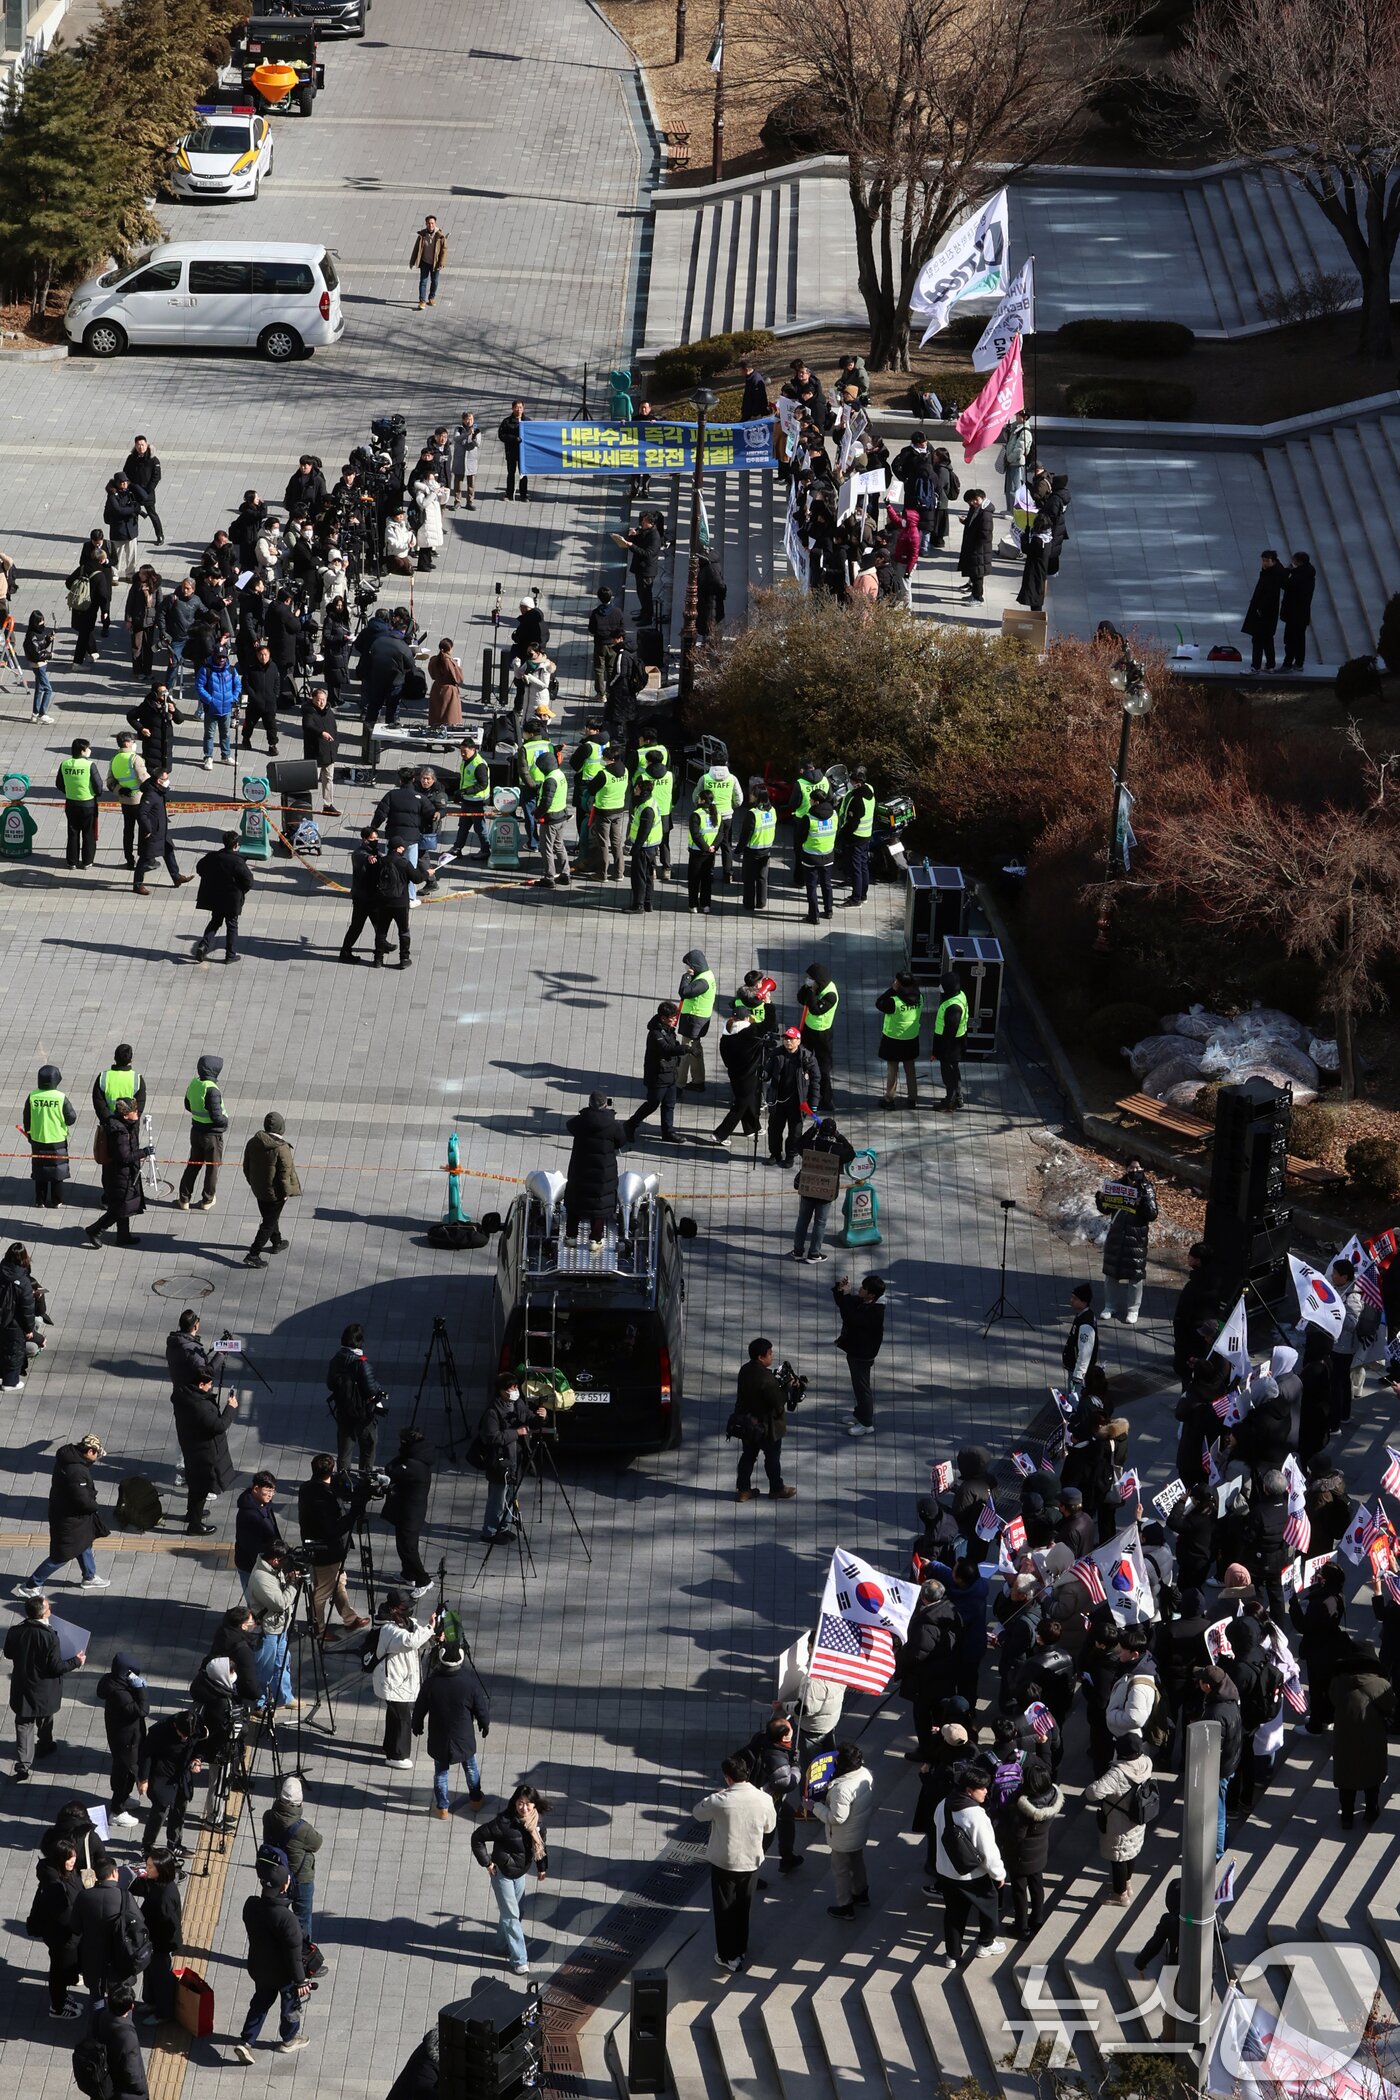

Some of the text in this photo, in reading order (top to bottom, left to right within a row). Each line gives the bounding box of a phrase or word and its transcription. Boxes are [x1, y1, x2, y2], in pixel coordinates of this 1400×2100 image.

[561, 427, 639, 446] 내란수괴
[644, 426, 684, 445] 즉각
[561, 448, 639, 468] 내란세력
[644, 447, 684, 467] 완전
[64, 768, 86, 776] STAFF
[611, 774, 628, 784] STAFF
[707, 781, 730, 789] STAFF
[806, 783, 826, 793] STAFF
[900, 1003, 922, 1012] STAFF
[34, 1099, 60, 1108] STAFF
[587, 1393, 608, 1402] 5512
[1154, 1481, 1183, 1508] 부정선거
[1311, 1555, 1331, 1569] STOP
